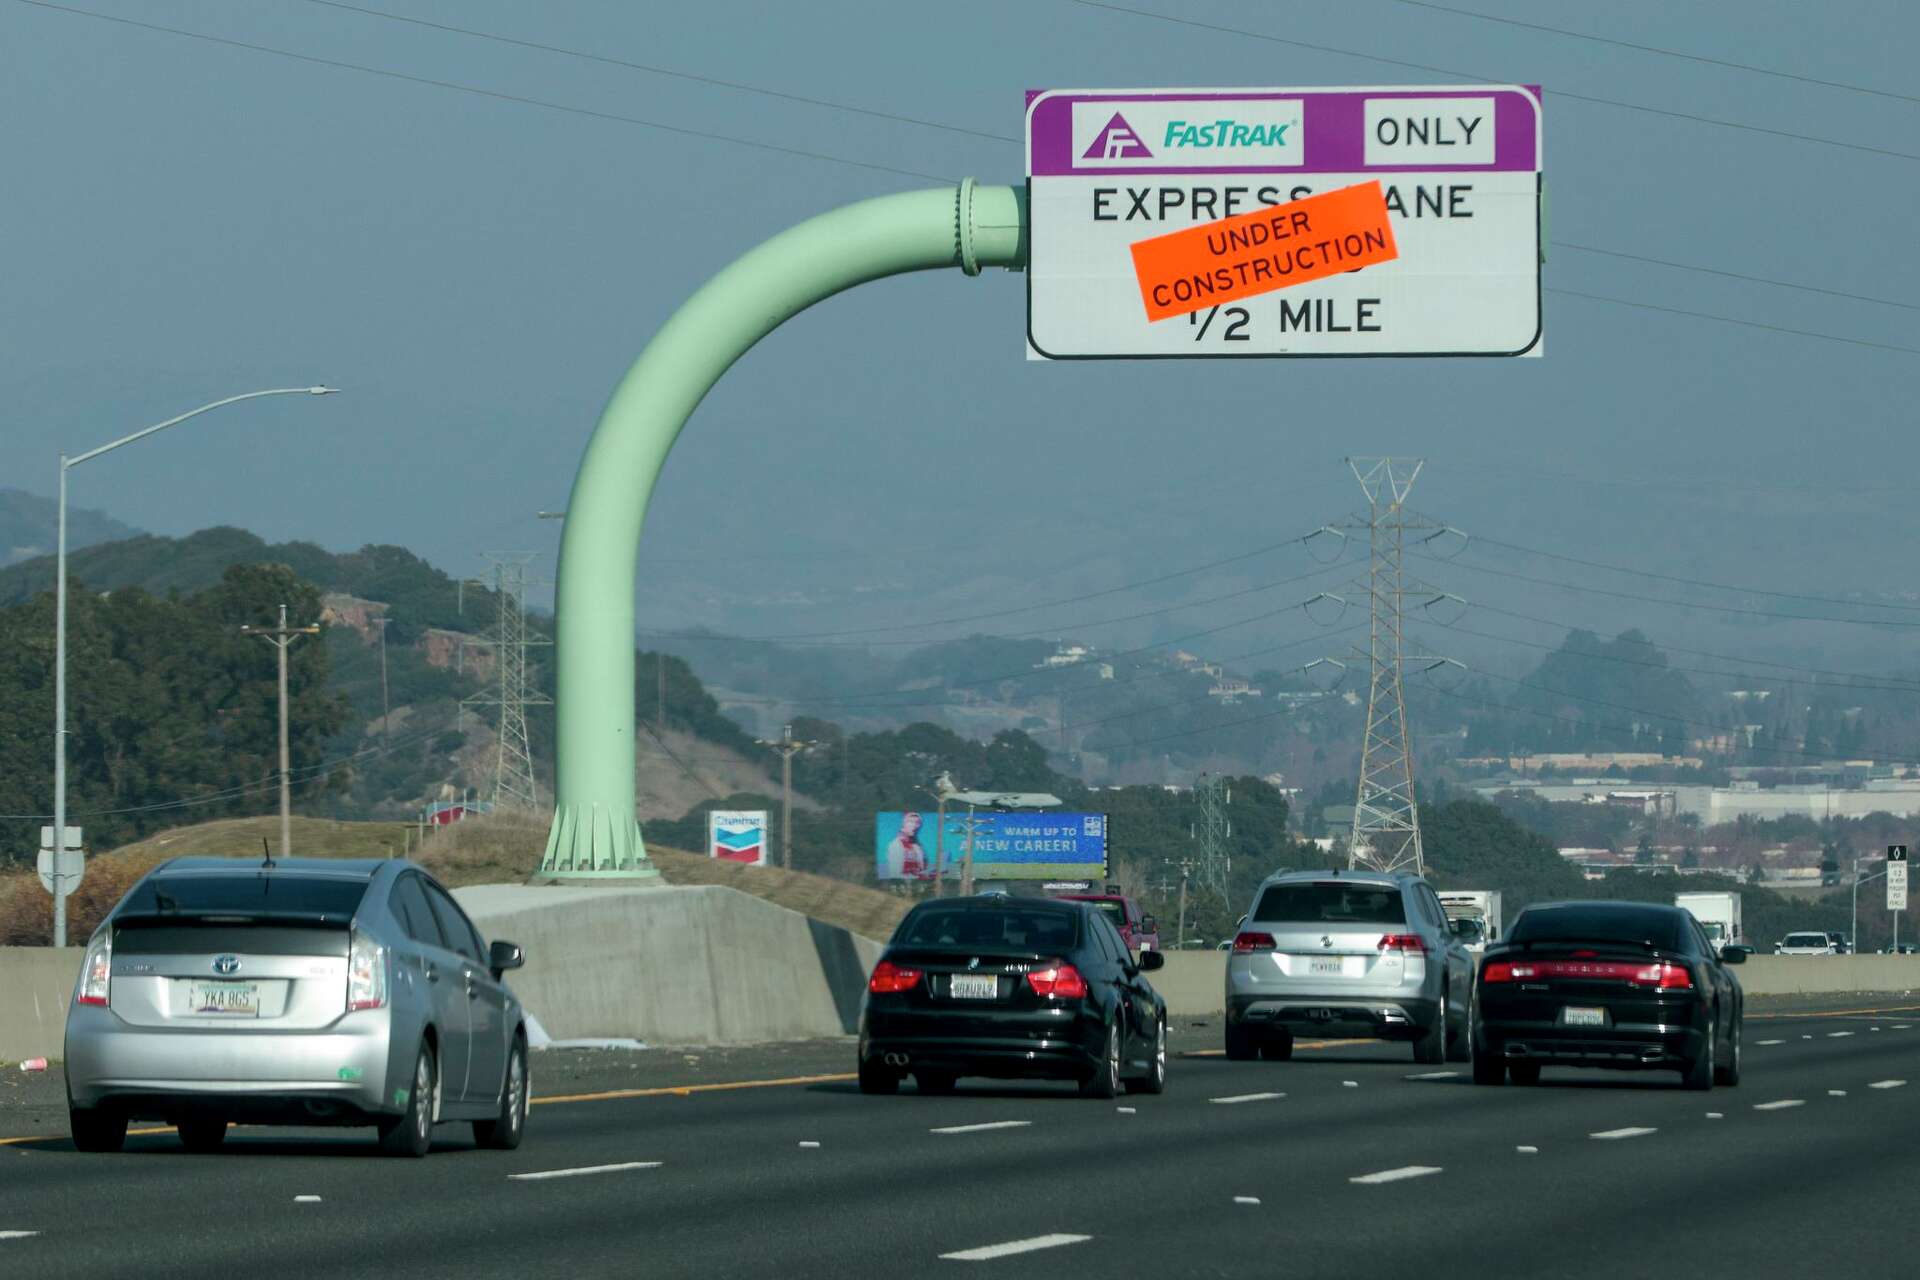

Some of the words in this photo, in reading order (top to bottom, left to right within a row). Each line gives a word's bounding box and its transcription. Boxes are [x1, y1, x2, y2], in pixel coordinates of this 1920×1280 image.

[1377, 116, 1483, 146] ONLY
[1384, 184, 1474, 218] ANE
[1207, 211, 1312, 256] UNDER
[1152, 227, 1386, 307] CONSTRUCTION
[1280, 298, 1382, 332] MILE
[975, 839, 1010, 851] NEW
[1015, 839, 1077, 852] CAREER!
[1004, 827, 1041, 836] WARM
[1043, 827, 1058, 836] UP
[1062, 827, 1077, 836] TO
